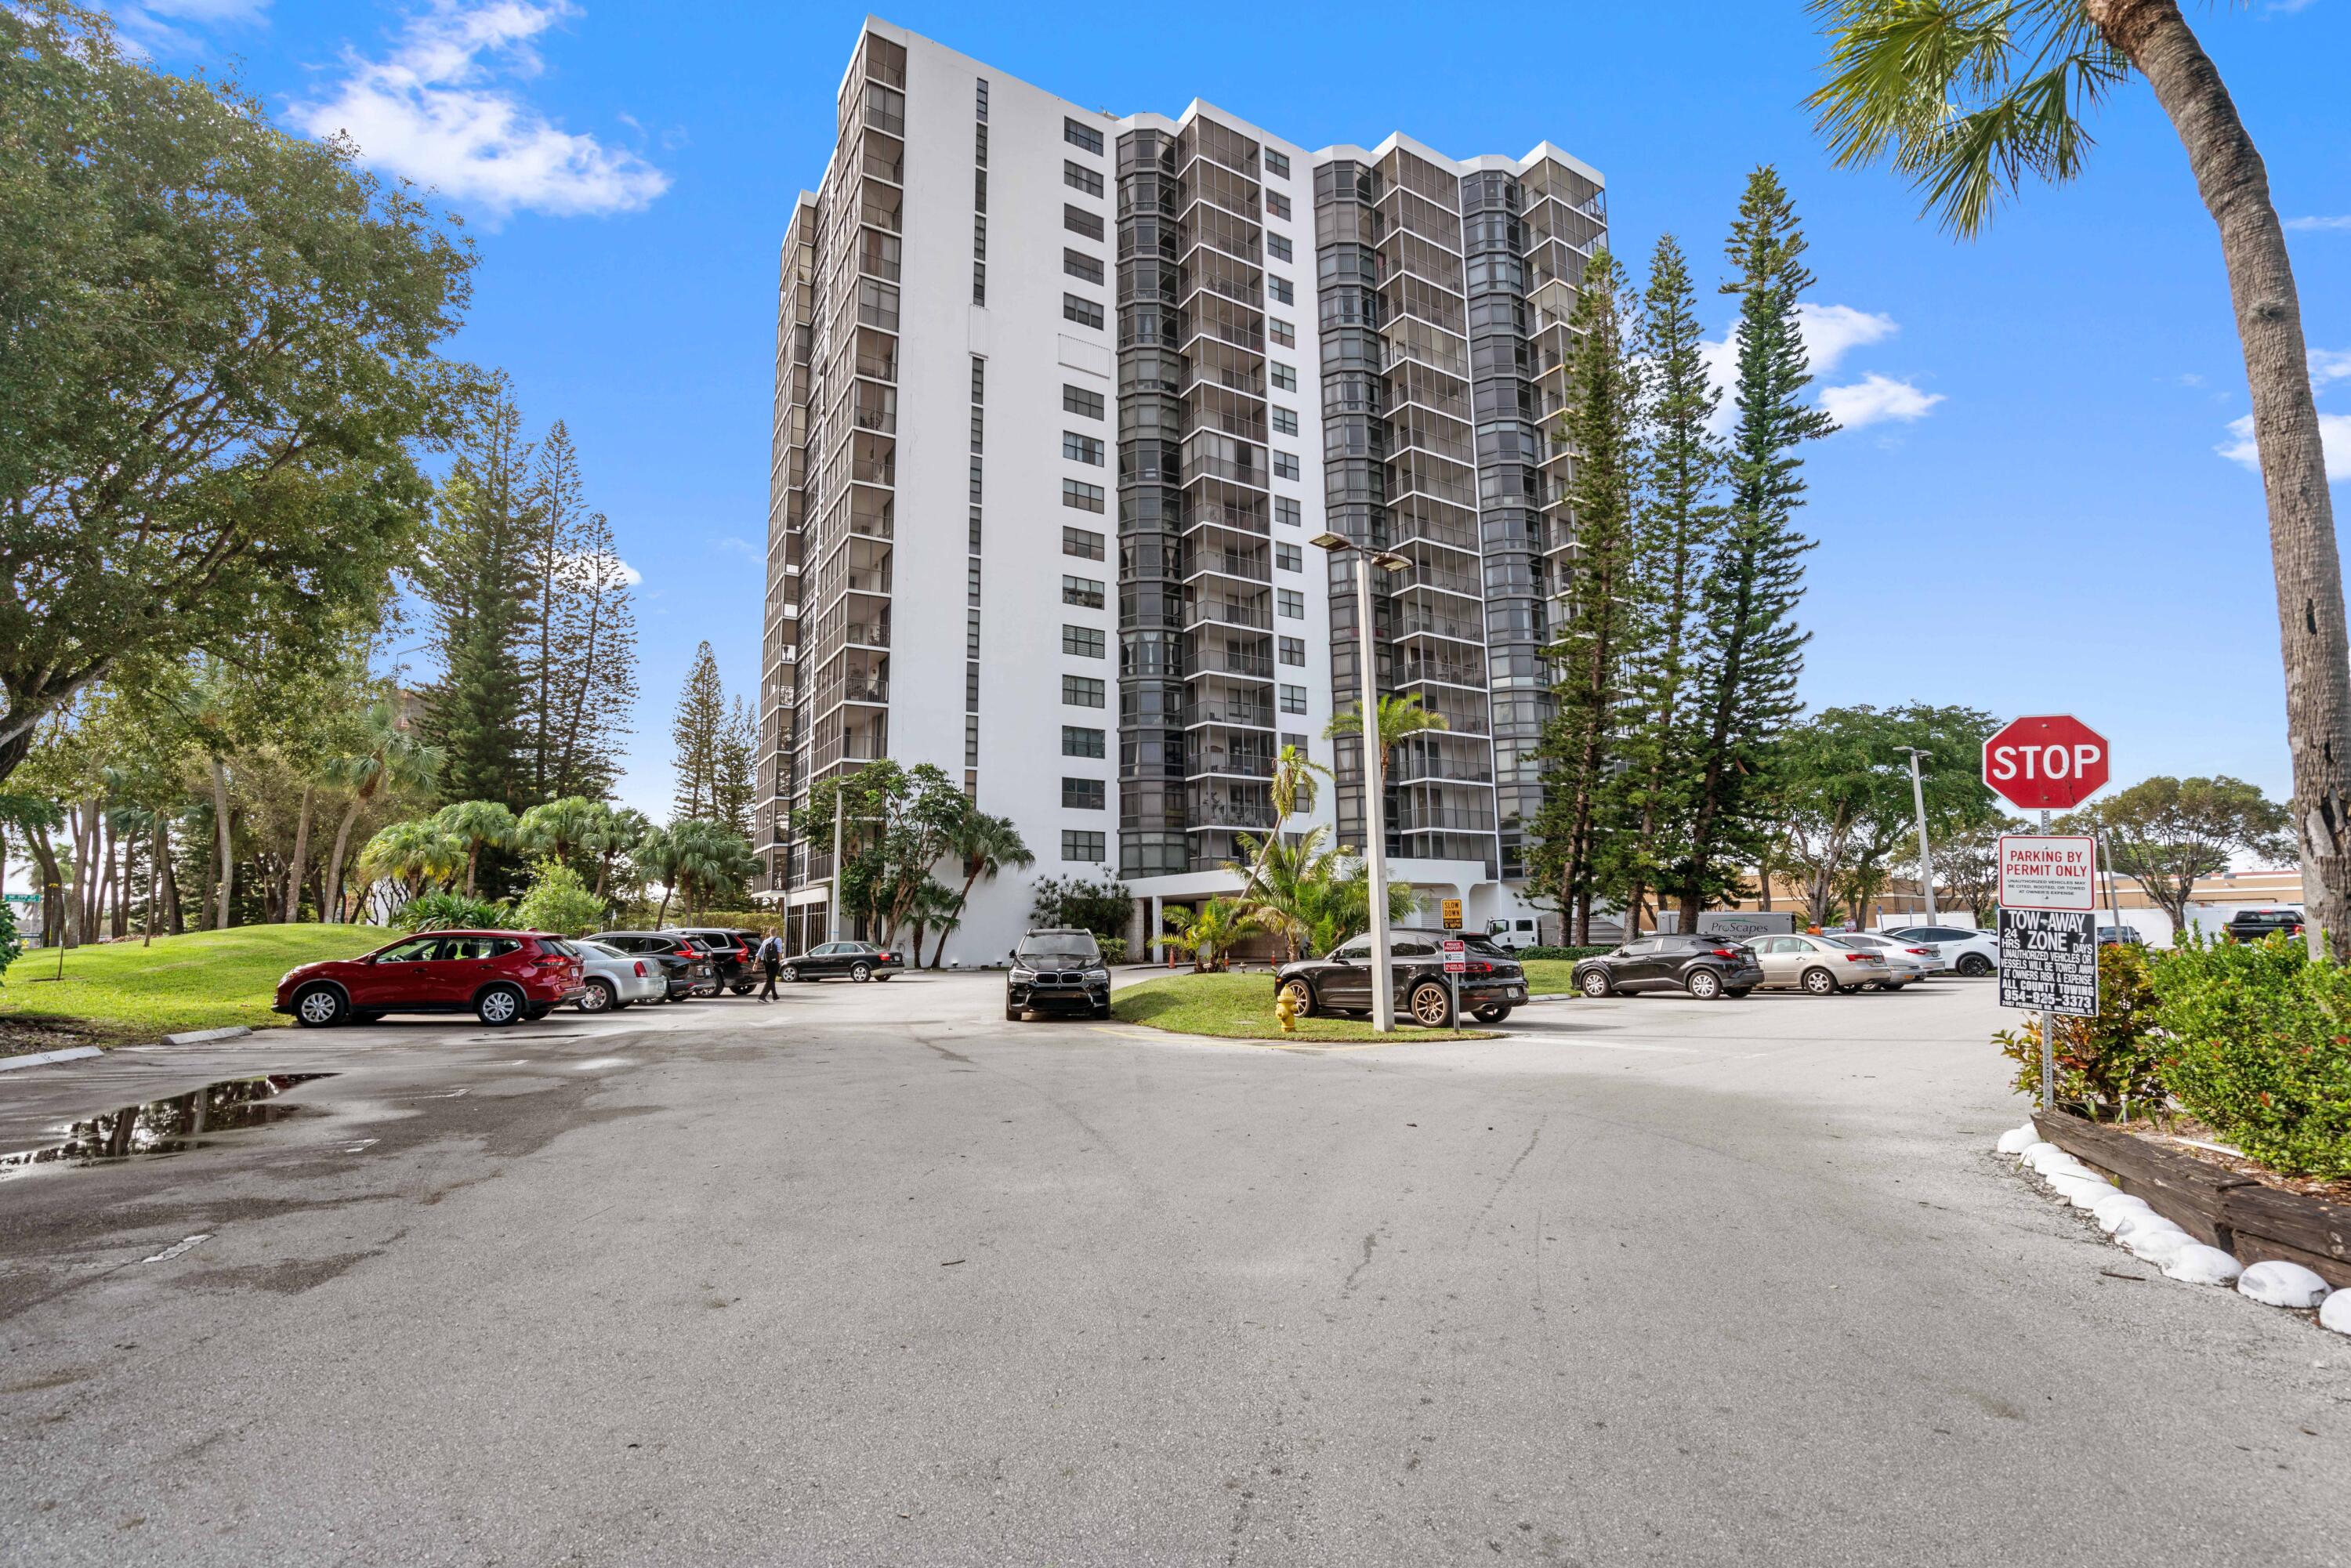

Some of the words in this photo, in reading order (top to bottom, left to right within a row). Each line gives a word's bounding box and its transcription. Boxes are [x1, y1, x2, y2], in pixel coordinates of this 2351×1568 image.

[1993, 744, 2101, 780] STOP
[2010, 850, 2063, 863] PARKING
[2067, 851, 2083, 863] BY
[2006, 864, 2051, 876] PERMIT
[2056, 865, 2087, 877] ONLY
[1711, 922, 1769, 934] ProScapes
[2008, 910, 2085, 932] TOW-AWAY
[2004, 928, 2018, 939] 24
[2027, 930, 2067, 951] ZONE
[2078, 932, 2087, 943] 7
[2001, 938, 2020, 949] HRS
[2073, 943, 2093, 954] DAYS
[2003, 949, 2048, 961] UNAUTHORIZED
[2050, 952, 2080, 964] VEHICLES
[2082, 954, 2092, 965] OR
[2000, 958, 2027, 969] VESSELS
[2029, 961, 2043, 971] WILL
[2045, 962, 2053, 972] BE
[2056, 963, 2077, 974] TOWED
[2078, 965, 2095, 976] AWAY
[2003, 969, 2010, 978] AT
[2012, 971, 2038, 980] OWNERS
[2040, 972, 2056, 982] RISK
[2056, 973, 2062, 983] &
[2063, 974, 2093, 986] EXPENSE
[2001, 979, 2018, 990] ALL
[2020, 980, 2056, 993] COUNTY
[2058, 984, 2095, 997] TOWING
[2004, 989, 2092, 1009] 954-925-3373
